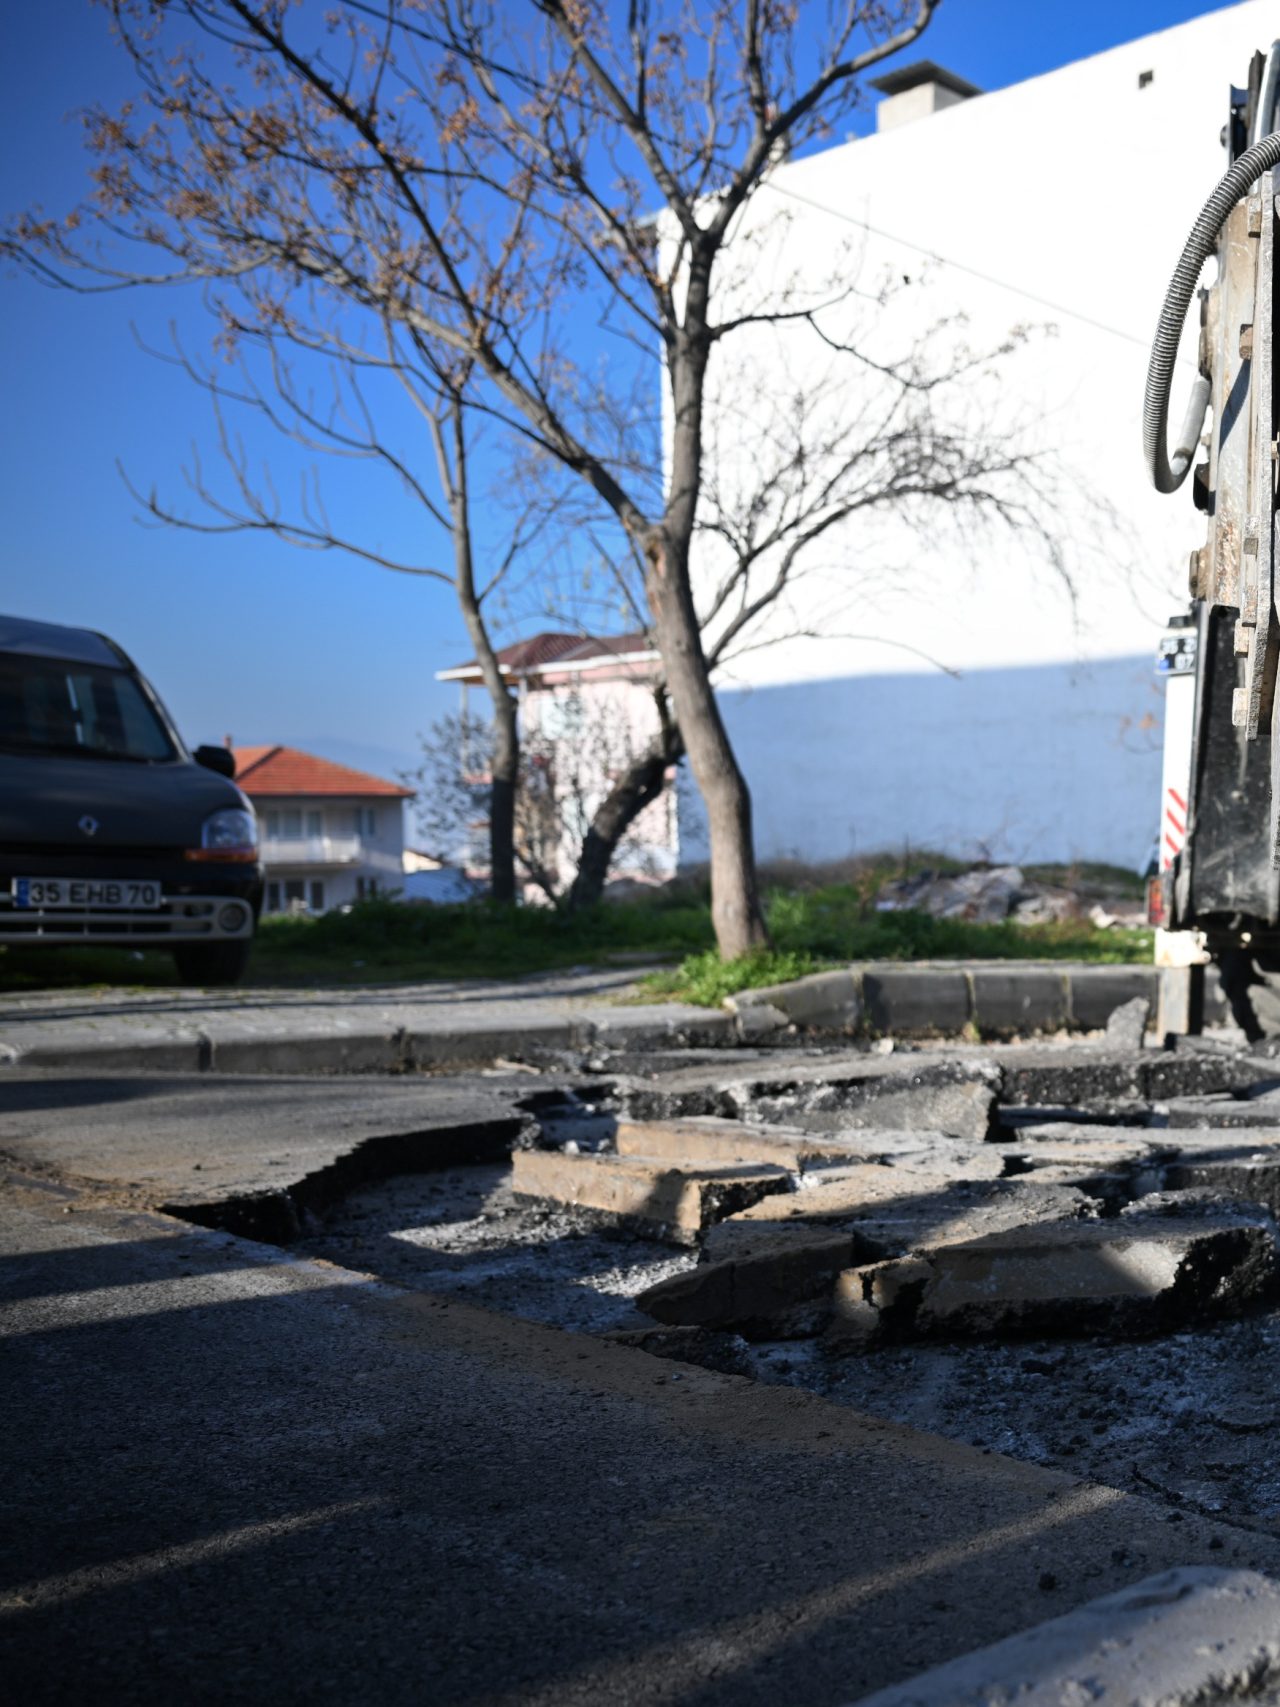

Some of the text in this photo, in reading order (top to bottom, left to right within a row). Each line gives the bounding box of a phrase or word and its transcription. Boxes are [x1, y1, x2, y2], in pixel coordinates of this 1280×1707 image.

[31, 881, 155, 906] 35 EHB 70
